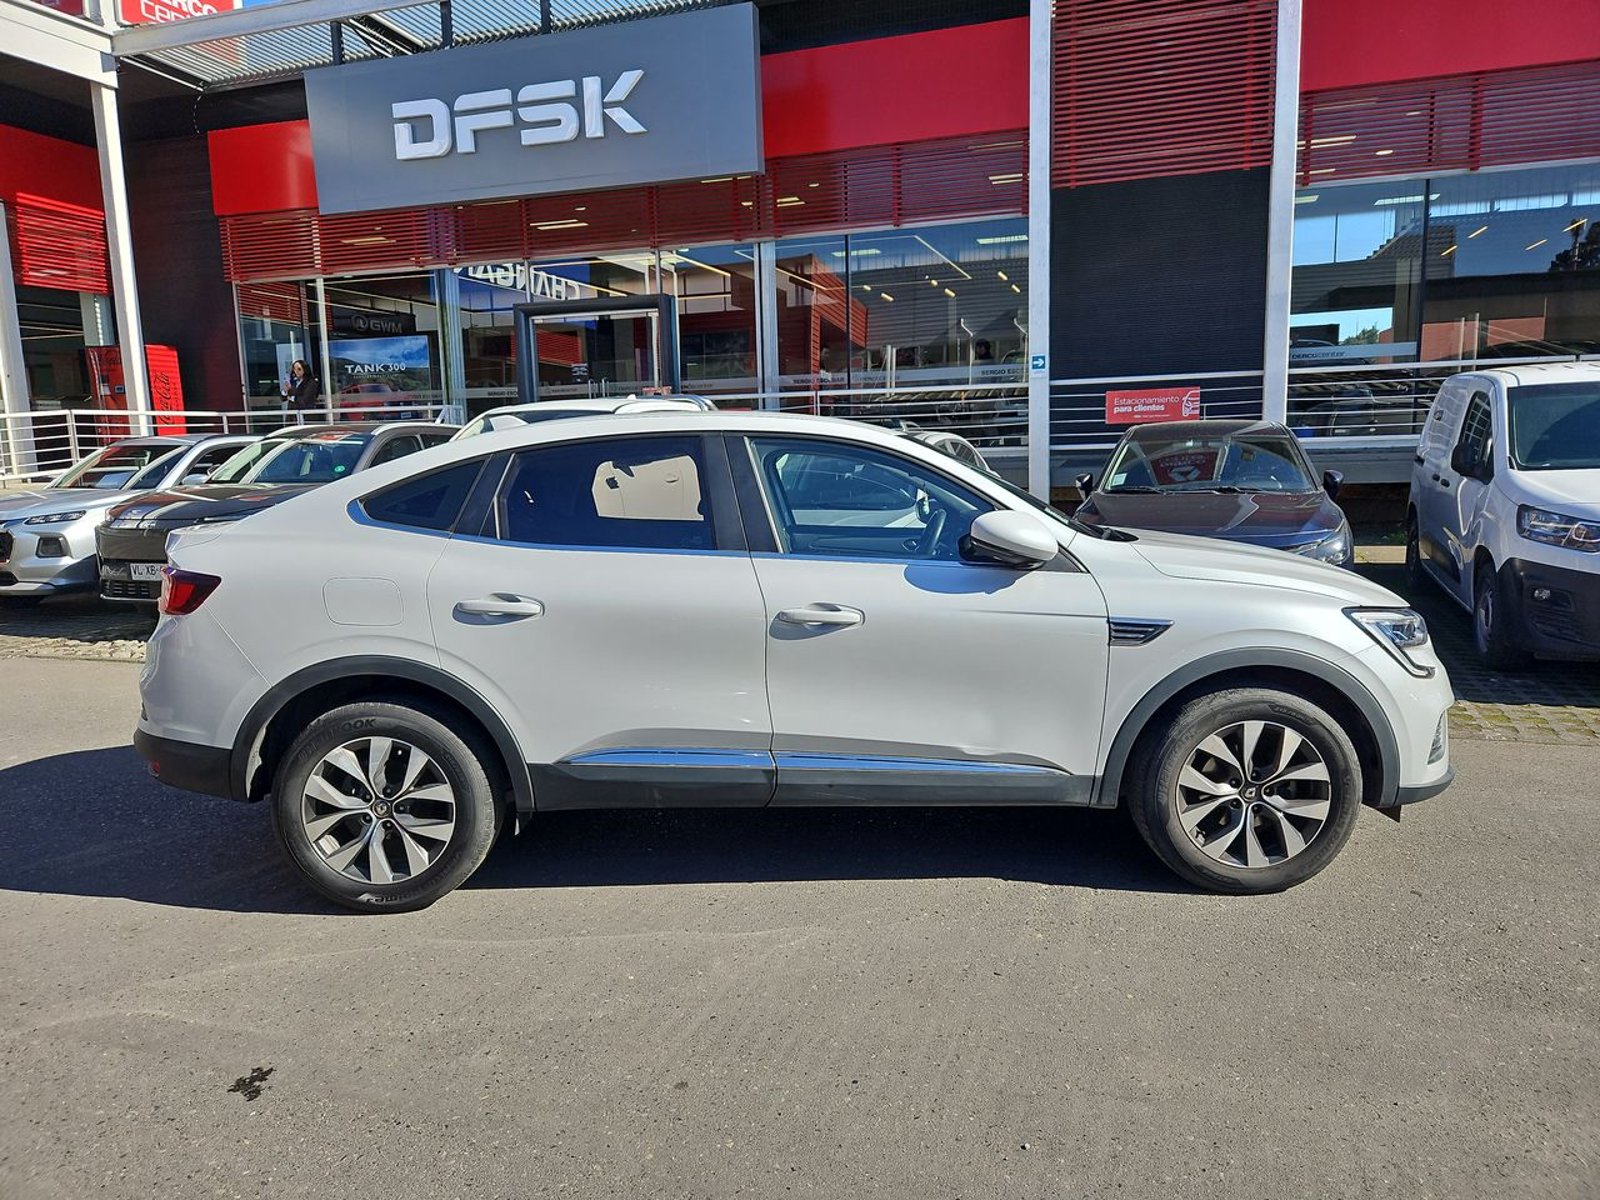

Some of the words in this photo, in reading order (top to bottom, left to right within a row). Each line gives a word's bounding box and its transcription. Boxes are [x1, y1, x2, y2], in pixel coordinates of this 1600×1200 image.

[391, 69, 648, 161] DFSK
[370, 320, 402, 333] GWM
[344, 363, 385, 375] TANK
[387, 362, 406, 372] 300
[1114, 396, 1180, 406] Estacionamiento
[1114, 405, 1132, 414] para
[1133, 404, 1165, 412] clientes
